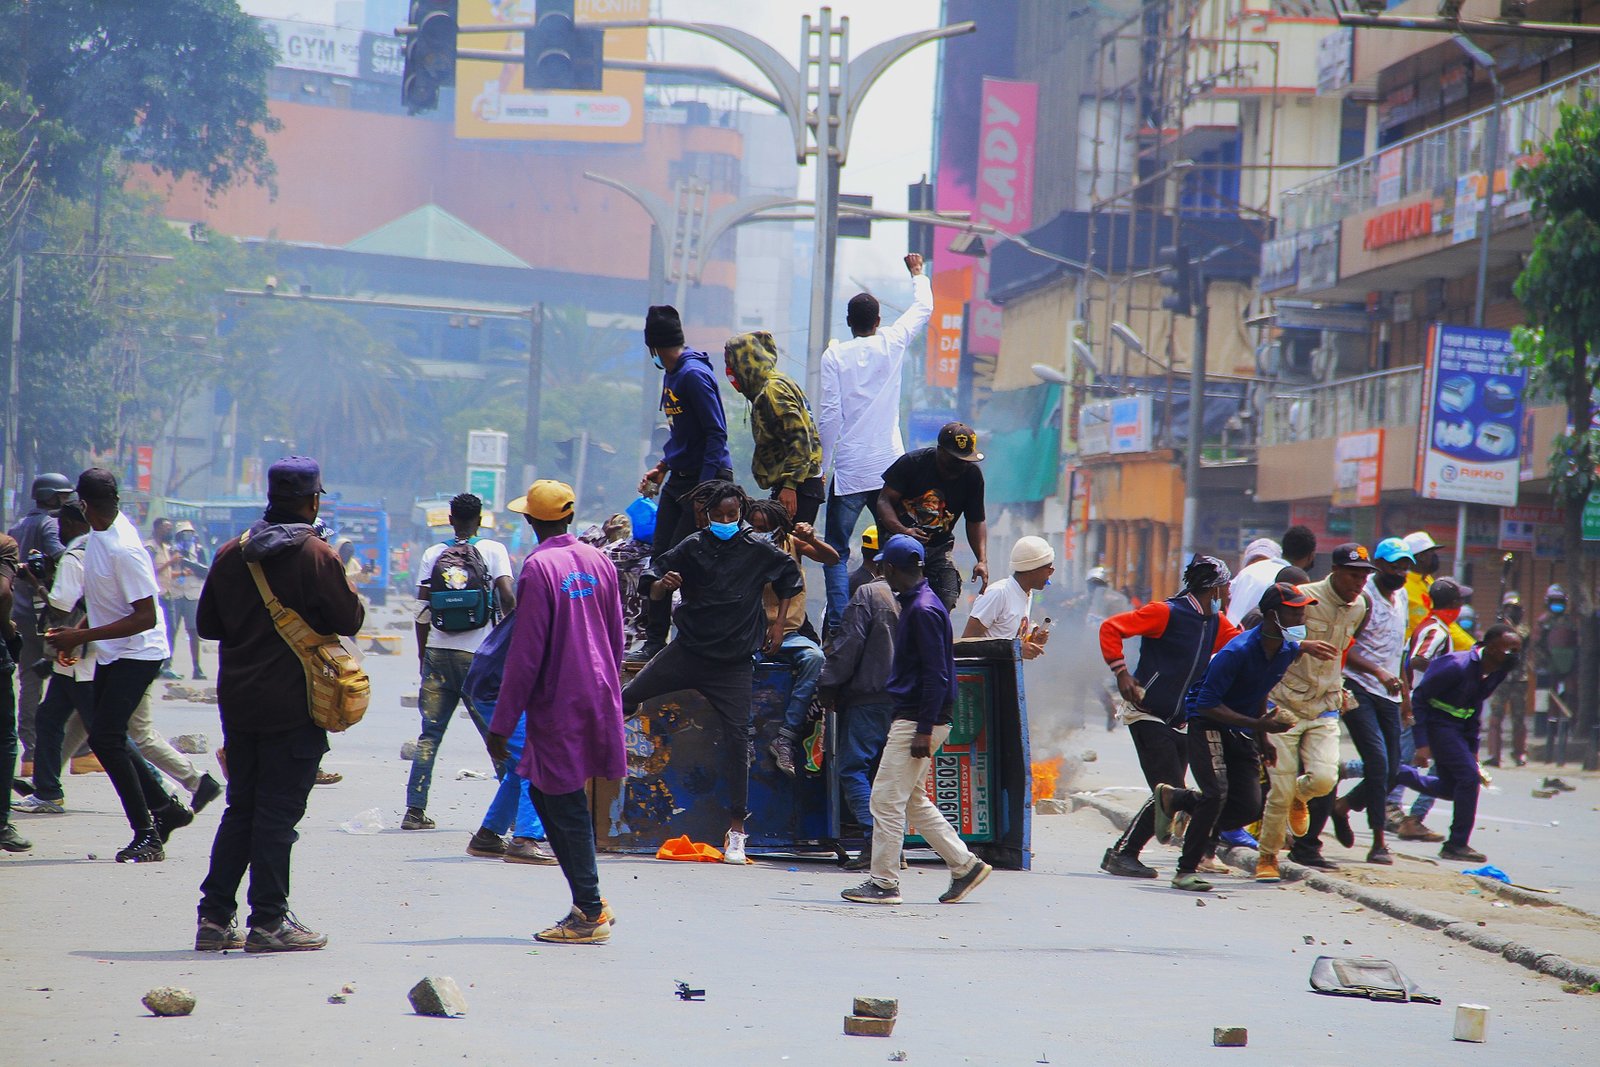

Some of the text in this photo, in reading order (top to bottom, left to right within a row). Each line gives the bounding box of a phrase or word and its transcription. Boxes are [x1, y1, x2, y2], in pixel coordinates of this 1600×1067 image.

[288, 35, 335, 61] GYM
[1461, 468, 1504, 481] RIKKO
[937, 757, 959, 833] 203960
[961, 764, 970, 828] AGENT NO.
